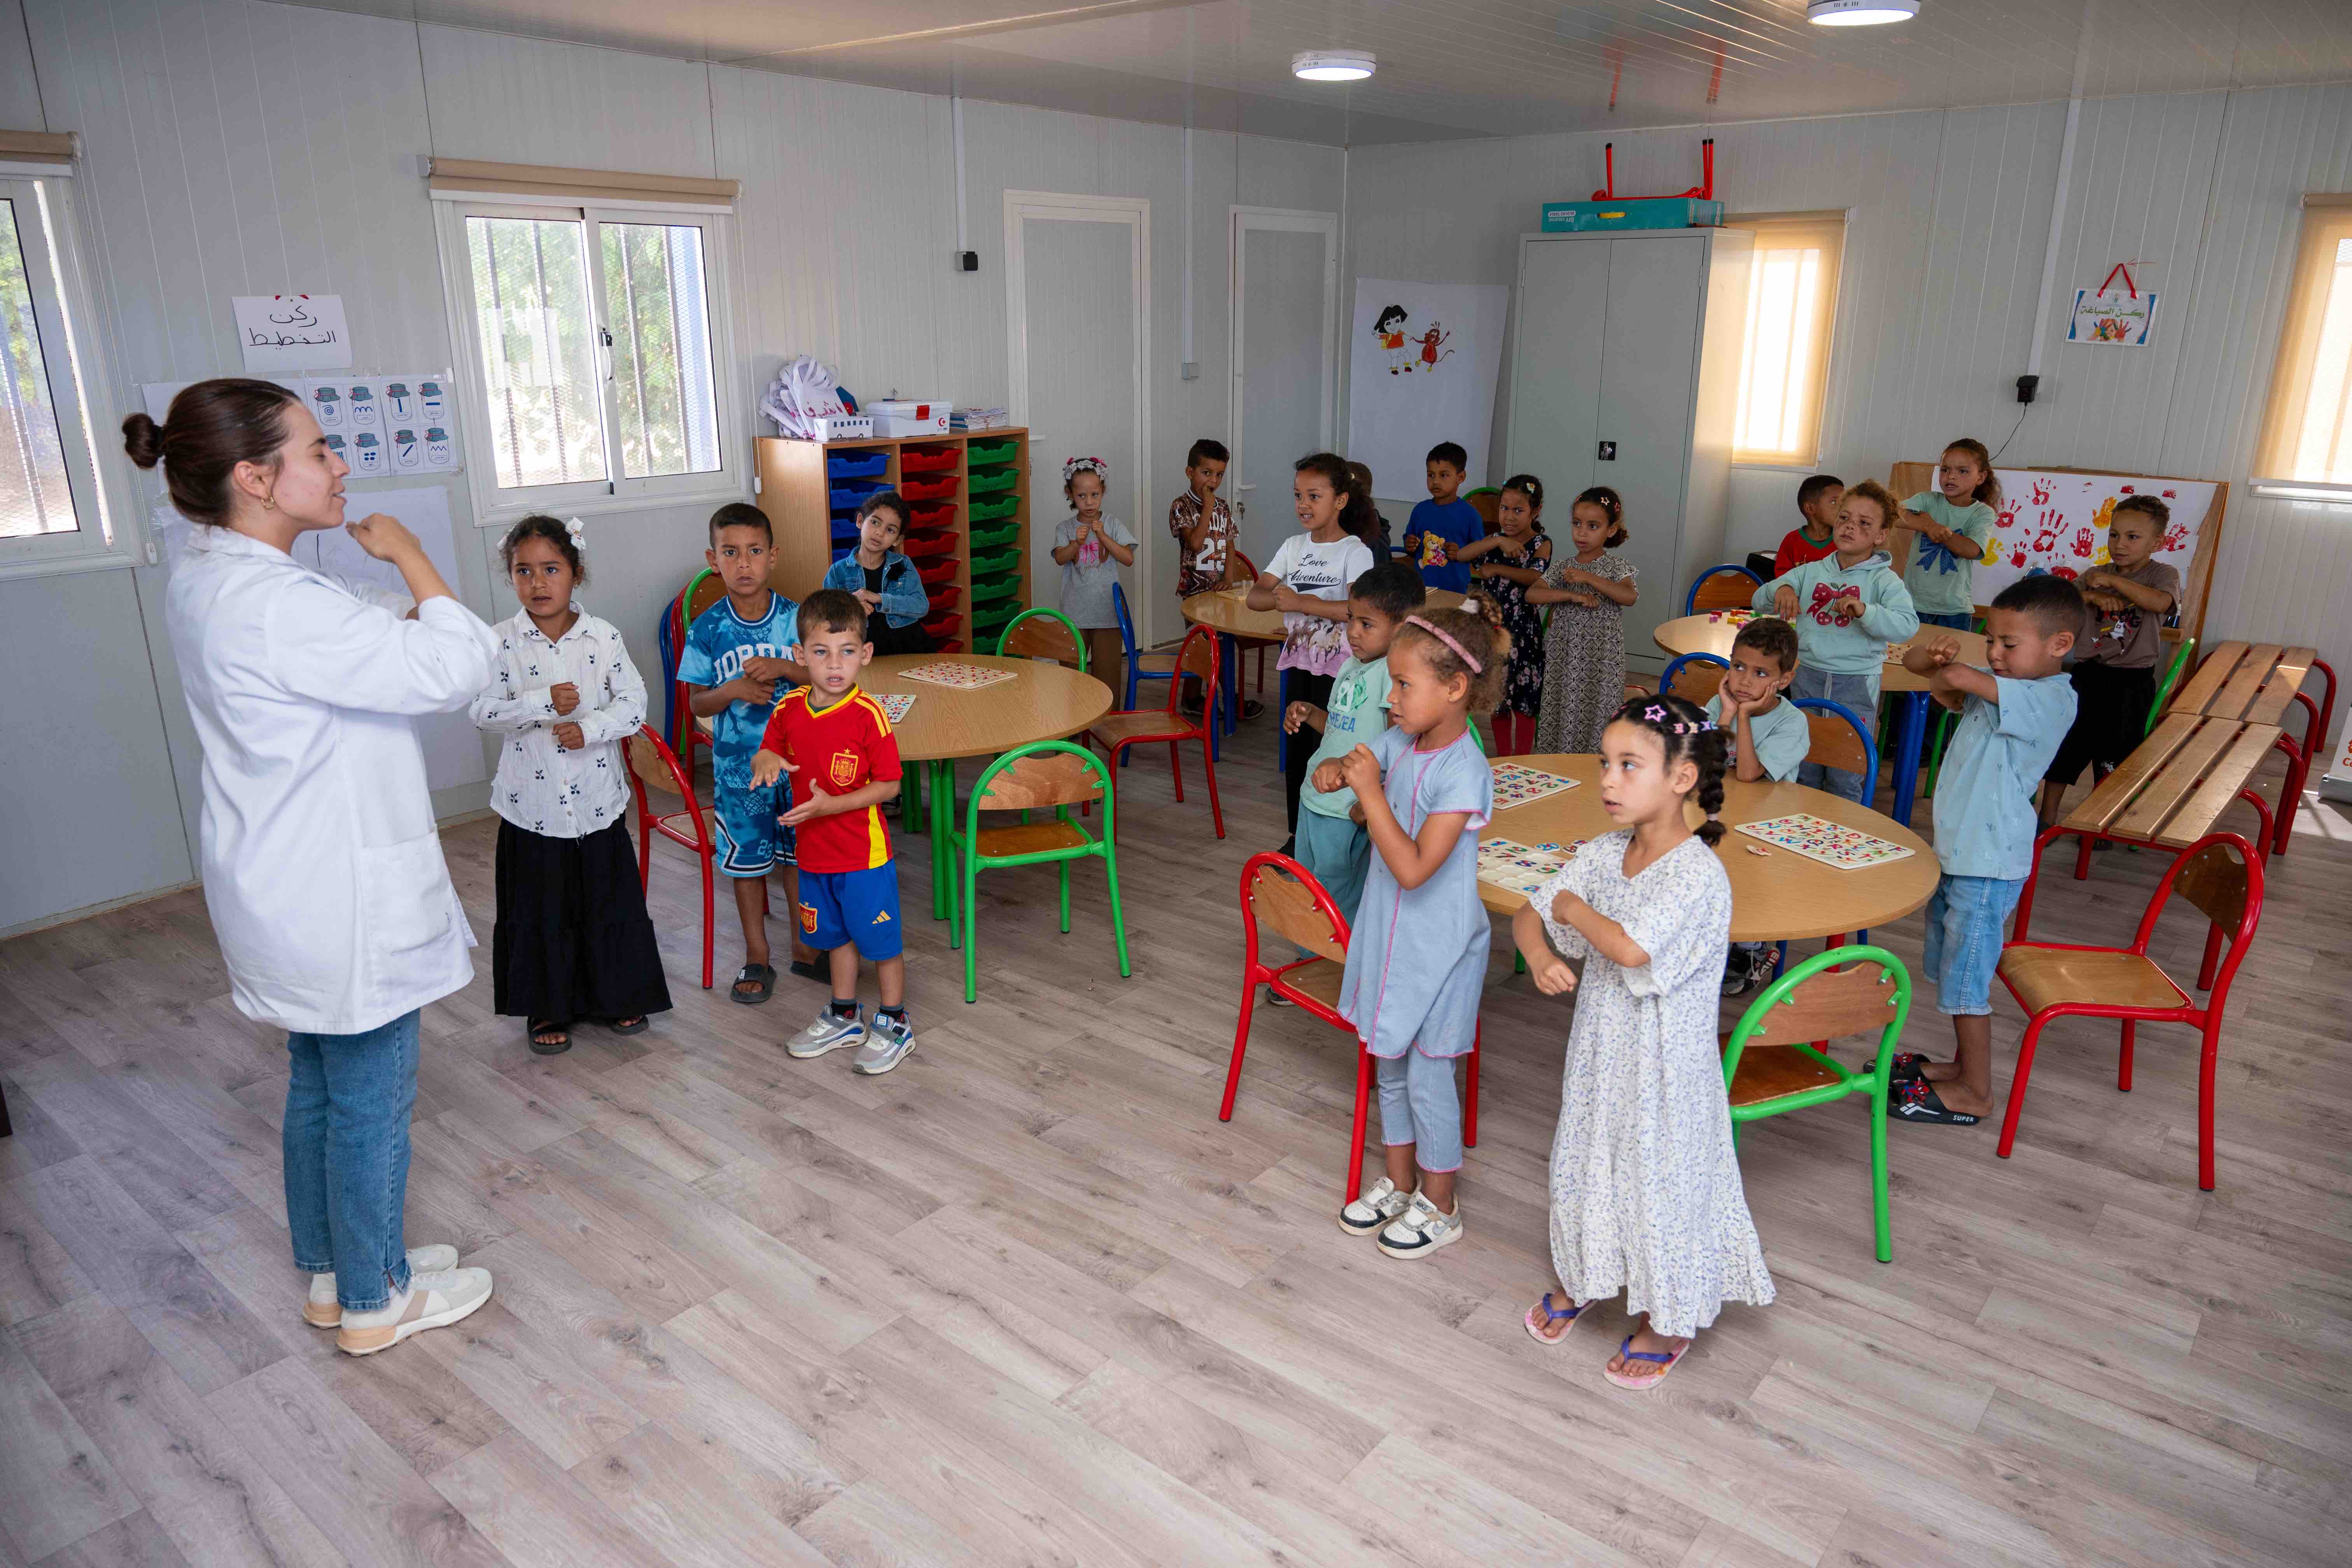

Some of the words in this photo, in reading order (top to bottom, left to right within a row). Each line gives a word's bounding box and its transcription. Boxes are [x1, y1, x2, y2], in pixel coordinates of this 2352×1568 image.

[270, 305, 317, 327] ركن
[249, 327, 336, 350] التخطيط
[1298, 554, 1328, 567] Love
[1288, 569, 1340, 583] Adventure
